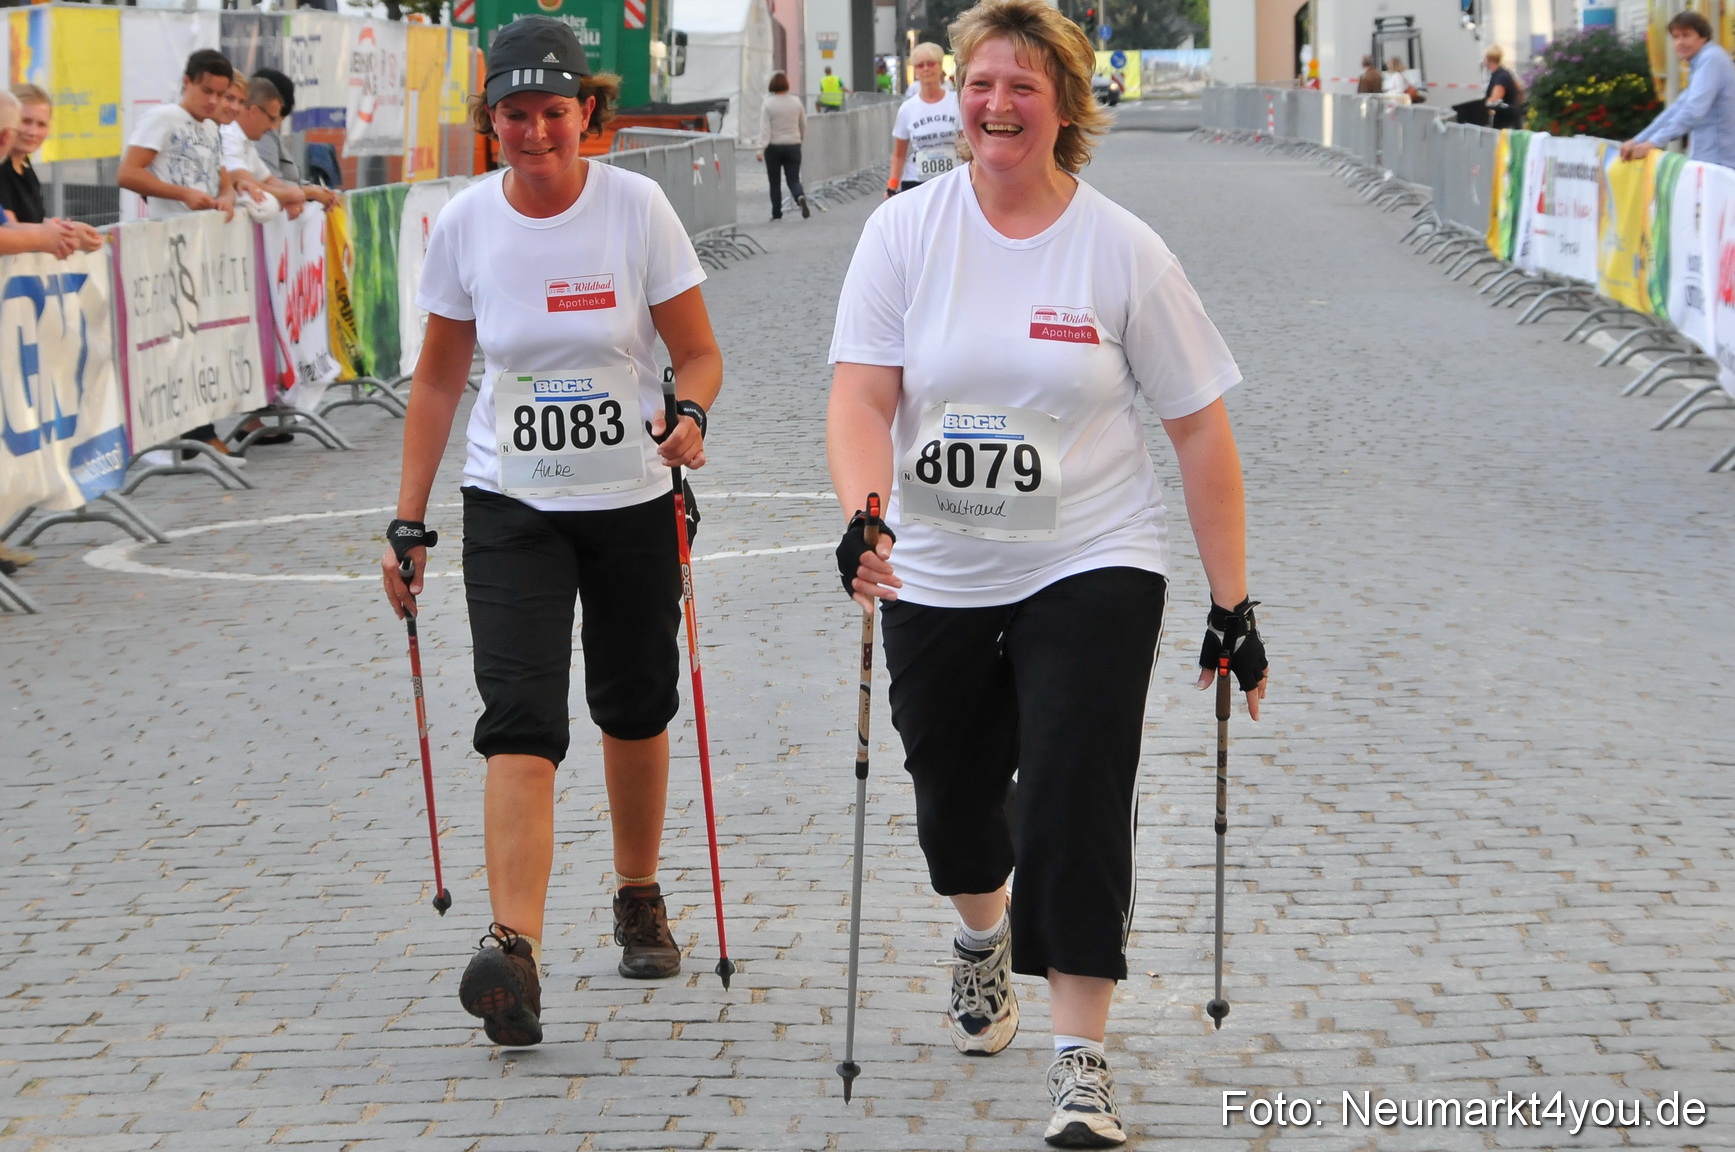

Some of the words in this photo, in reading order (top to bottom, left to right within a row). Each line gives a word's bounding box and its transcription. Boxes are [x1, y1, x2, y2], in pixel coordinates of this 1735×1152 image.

[913, 114, 956, 129] BERGER
[922, 158, 954, 174] 8088
[572, 280, 611, 292] Wildbad
[558, 297, 606, 309] Apotheke
[1041, 326, 1092, 339] Apotheke
[533, 378, 593, 393] BOCK
[513, 400, 625, 452] 8083
[943, 414, 1007, 430] BOCK
[916, 439, 1042, 493] 8079
